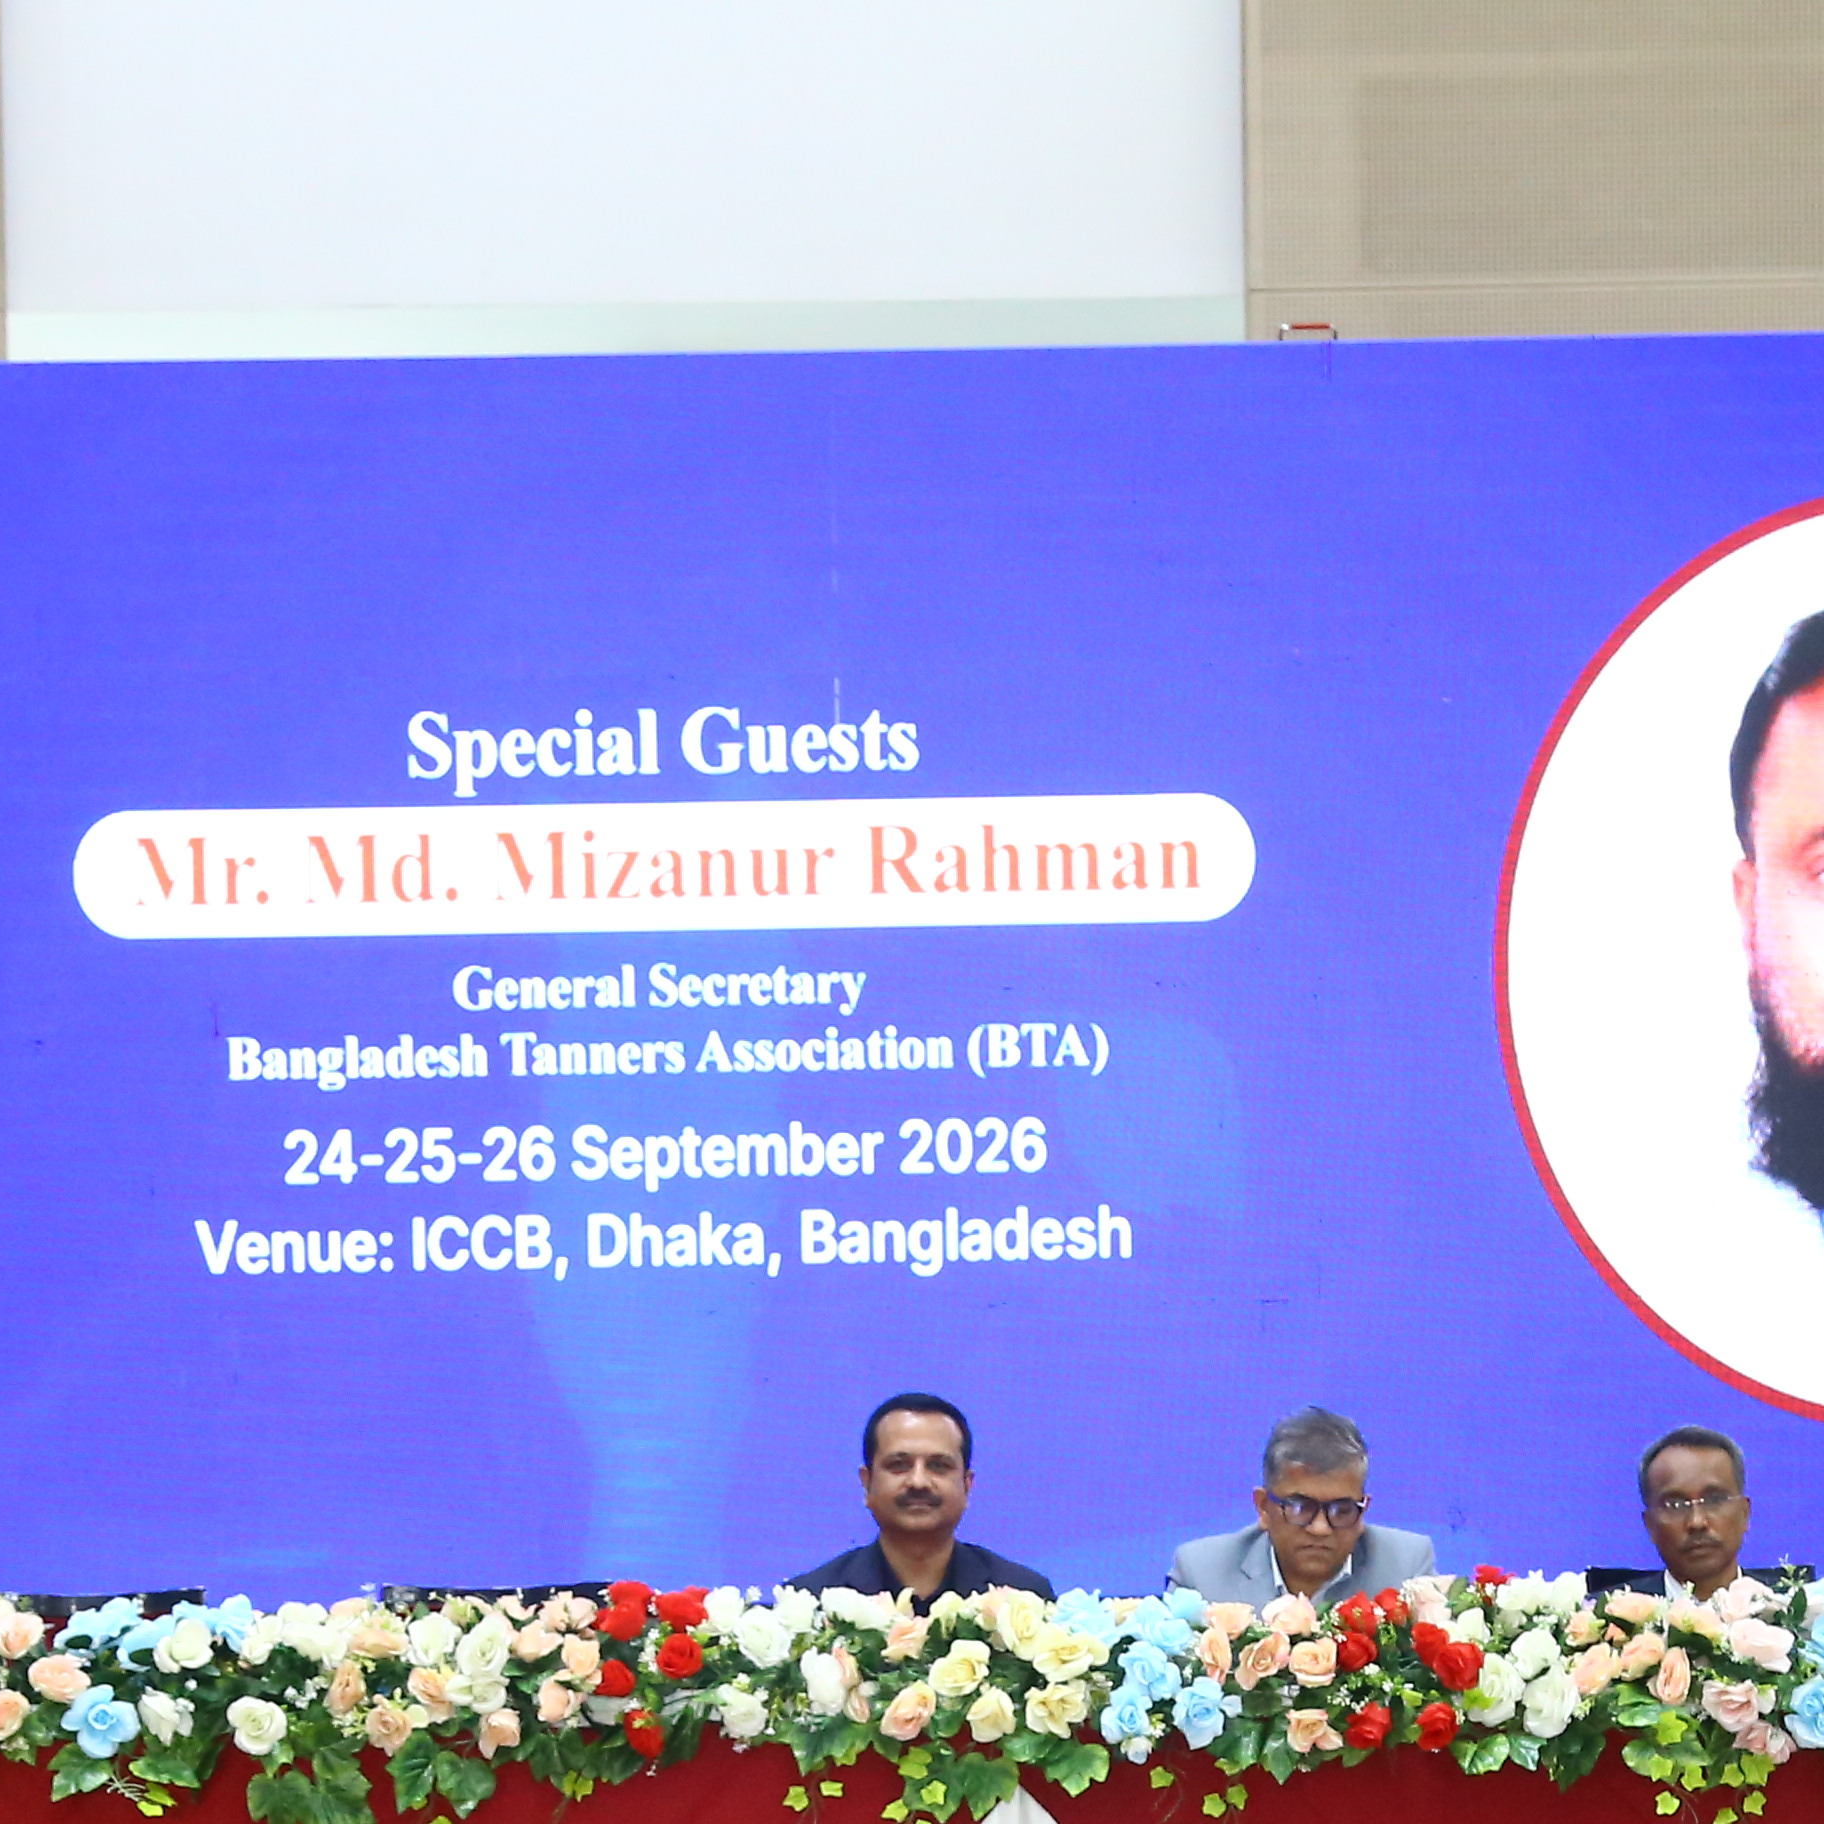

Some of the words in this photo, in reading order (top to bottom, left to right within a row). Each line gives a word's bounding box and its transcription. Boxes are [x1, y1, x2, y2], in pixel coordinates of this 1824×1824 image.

[407, 707, 661, 799] Special
[680, 705, 921, 775] Guests
[137, 837, 269, 906] Mr.
[307, 833, 458, 904] Md.
[496, 829, 835, 901] Mizanur
[869, 824, 1200, 895] Rahman
[452, 963, 637, 1011] General
[648, 962, 867, 1017] Secretary
[226, 1032, 489, 1092] Bangladesh
[496, 1031, 687, 1077] Tanners
[694, 1024, 955, 1073] Association
[966, 1022, 1110, 1076] (BTA)
[283, 1124, 557, 1186] 24-25-26
[570, 1120, 885, 1193] September
[898, 1115, 1048, 1175] 2026
[194, 1218, 395, 1275] Venue:
[411, 1213, 569, 1281] ICCB,
[586, 1210, 782, 1278] Dhaka,
[800, 1203, 1133, 1277] Bangladesh
